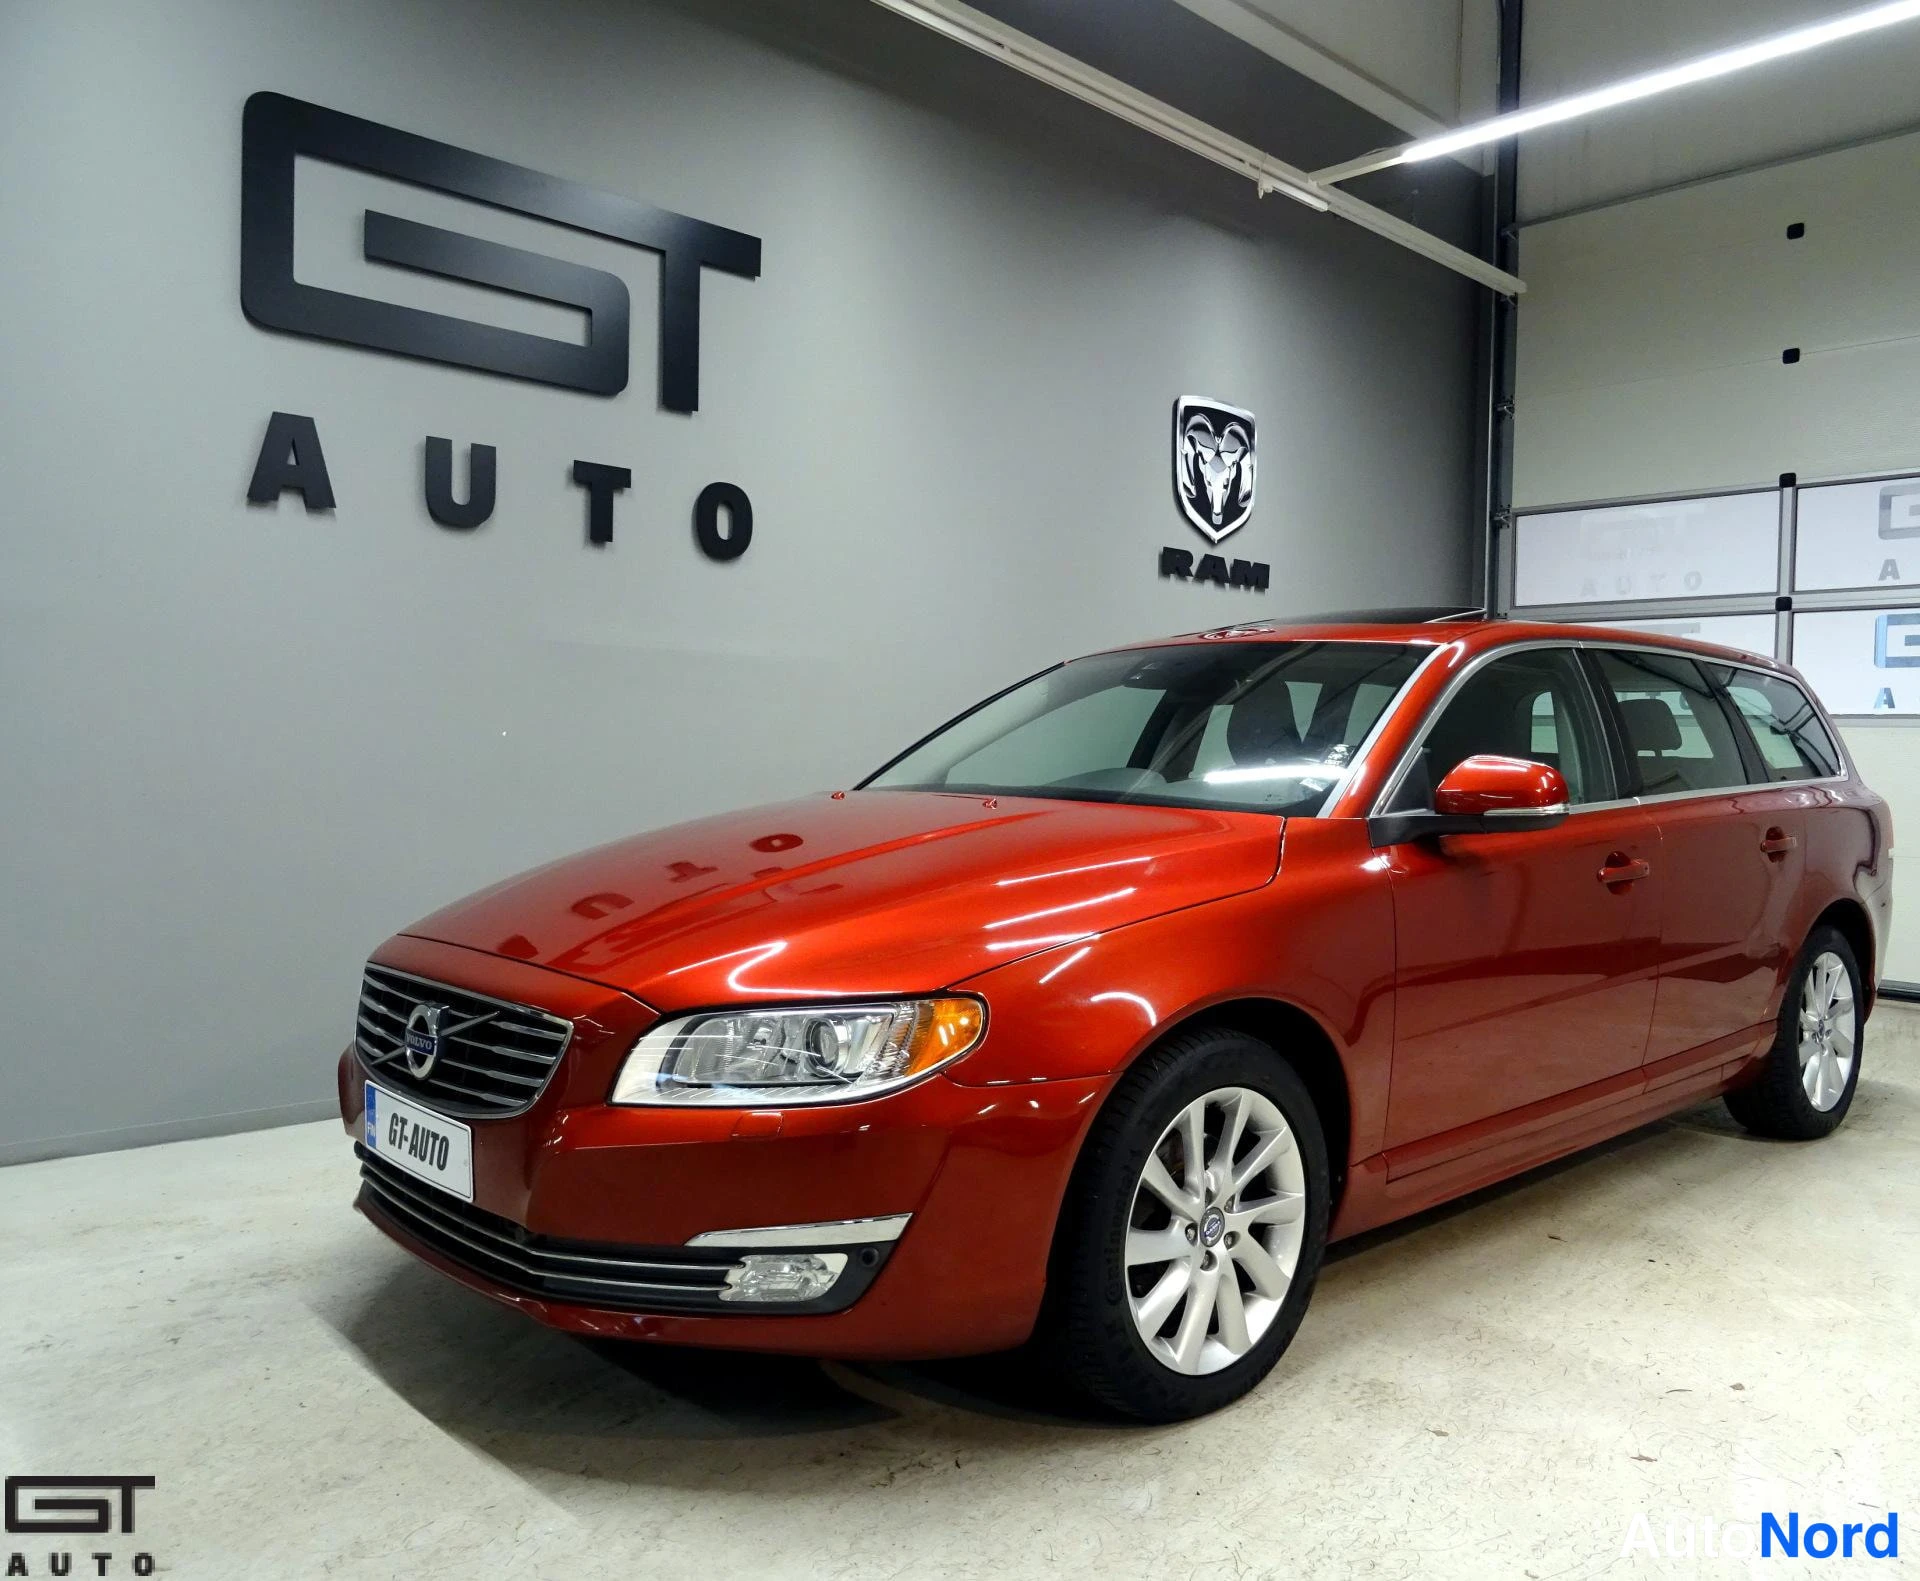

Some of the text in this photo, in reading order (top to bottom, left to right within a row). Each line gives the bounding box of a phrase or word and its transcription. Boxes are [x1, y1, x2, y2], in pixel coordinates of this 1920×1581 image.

[247, 411, 754, 561] AUTO
[1160, 546, 1271, 590] RAM
[406, 1032, 433, 1051] VOLVO
[388, 1112, 450, 1172] GT-AUTO
